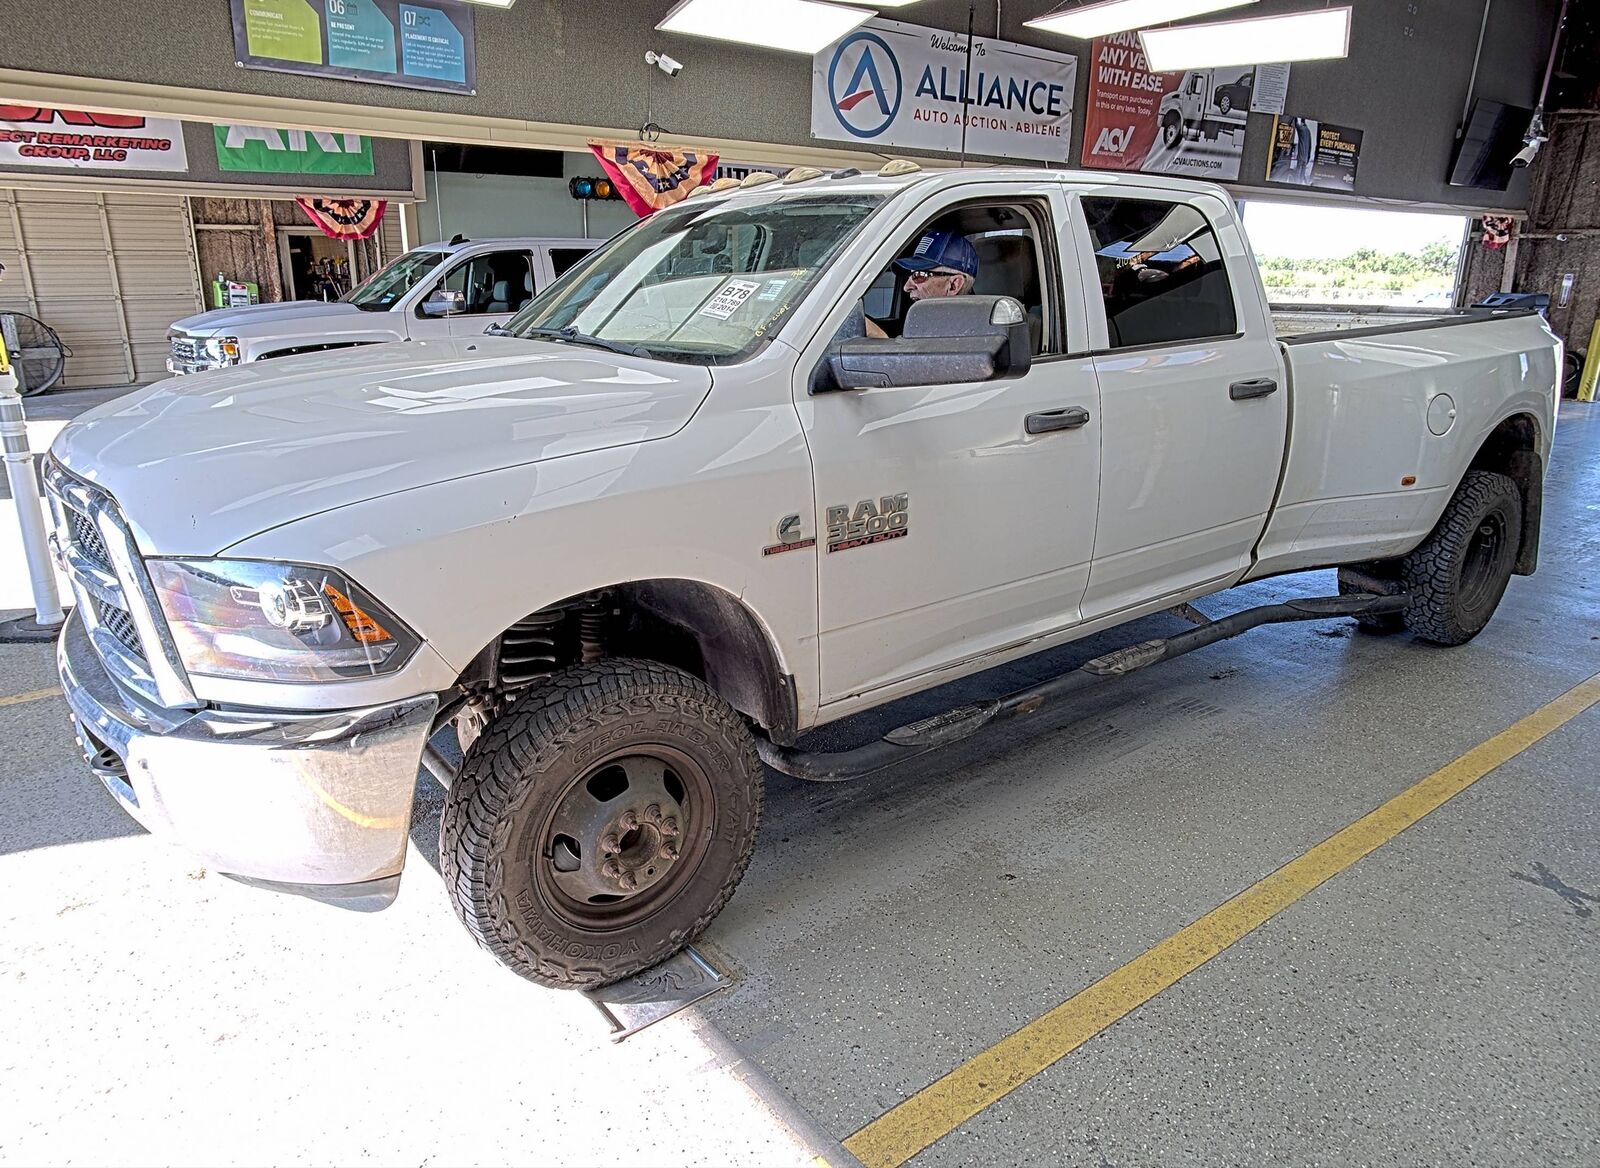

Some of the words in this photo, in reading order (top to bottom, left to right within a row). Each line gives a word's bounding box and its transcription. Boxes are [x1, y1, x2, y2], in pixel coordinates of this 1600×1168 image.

[330, 0, 344, 14] 06
[404, 10, 416, 26] 07
[930, 34, 971, 54] Welcom
[975, 42, 986, 56] To
[1098, 46, 1128, 66] ANY
[915, 64, 1064, 116] ALLIANCE
[1098, 66, 1131, 87] WITH
[1131, 72, 1164, 93] EASE.
[1097, 90, 1118, 100] Transport
[1130, 96, 1153, 105] purchased
[914, 108, 948, 124] AUTO
[954, 112, 1007, 132] AUCTION
[1016, 124, 1060, 137] ABILENE
[37, 131, 171, 150] REMARKETING
[1091, 126, 1135, 155] ACV
[19, 145, 91, 160] GROUP,
[93, 148, 127, 161] LLC
[721, 286, 750, 299] B78
[826, 492, 908, 524] RAM
[827, 511, 908, 543] 3500
[831, 536, 872, 552] HEAVY
[873, 530, 905, 543] DUTY
[515, 888, 640, 960] YOKOHAMA
